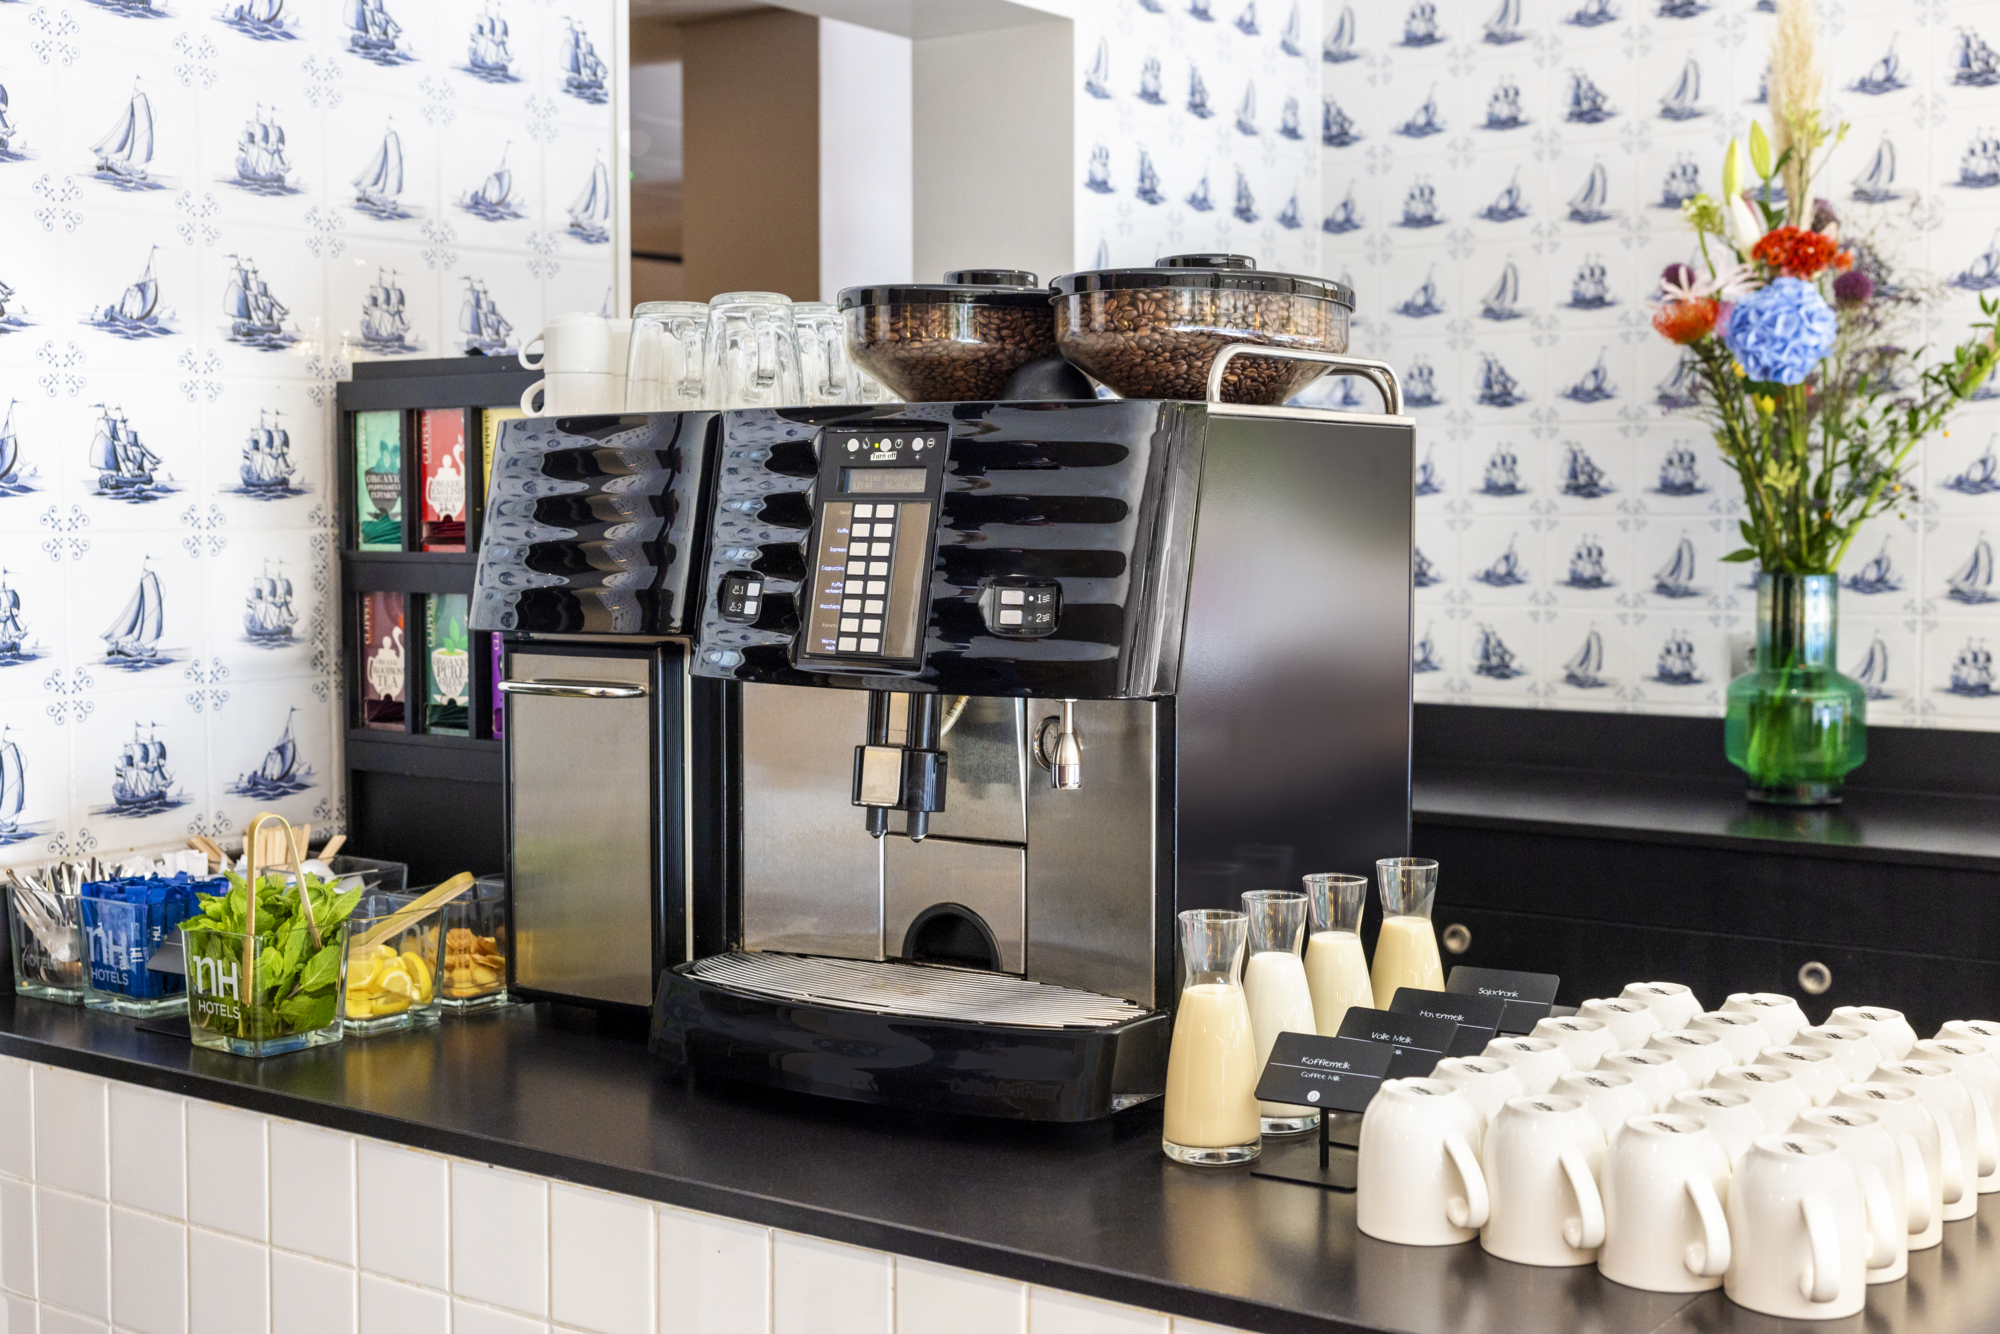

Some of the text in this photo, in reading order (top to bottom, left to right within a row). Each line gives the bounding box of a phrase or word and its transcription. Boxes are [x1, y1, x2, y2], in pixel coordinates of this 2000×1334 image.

[872, 451, 897, 459] Turn off
[432, 488, 464, 496] ENGLISH
[439, 503, 457, 513] TEA
[1037, 594, 1042, 604] 1
[736, 603, 742, 612] 2
[1035, 613, 1042, 623] 2
[437, 666, 465, 678] PURE
[377, 675, 398, 688] TEA
[91, 967, 129, 986] HOTELS
[1478, 987, 1519, 998] Sojadrank
[198, 1000, 240, 1020] HOTELS
[1420, 1009, 1464, 1021] Havermelk
[1371, 1031, 1413, 1044] Volle Melk
[1301, 1056, 1351, 1070] Koffiemelk
[1300, 1070, 1327, 1080] Coffee
